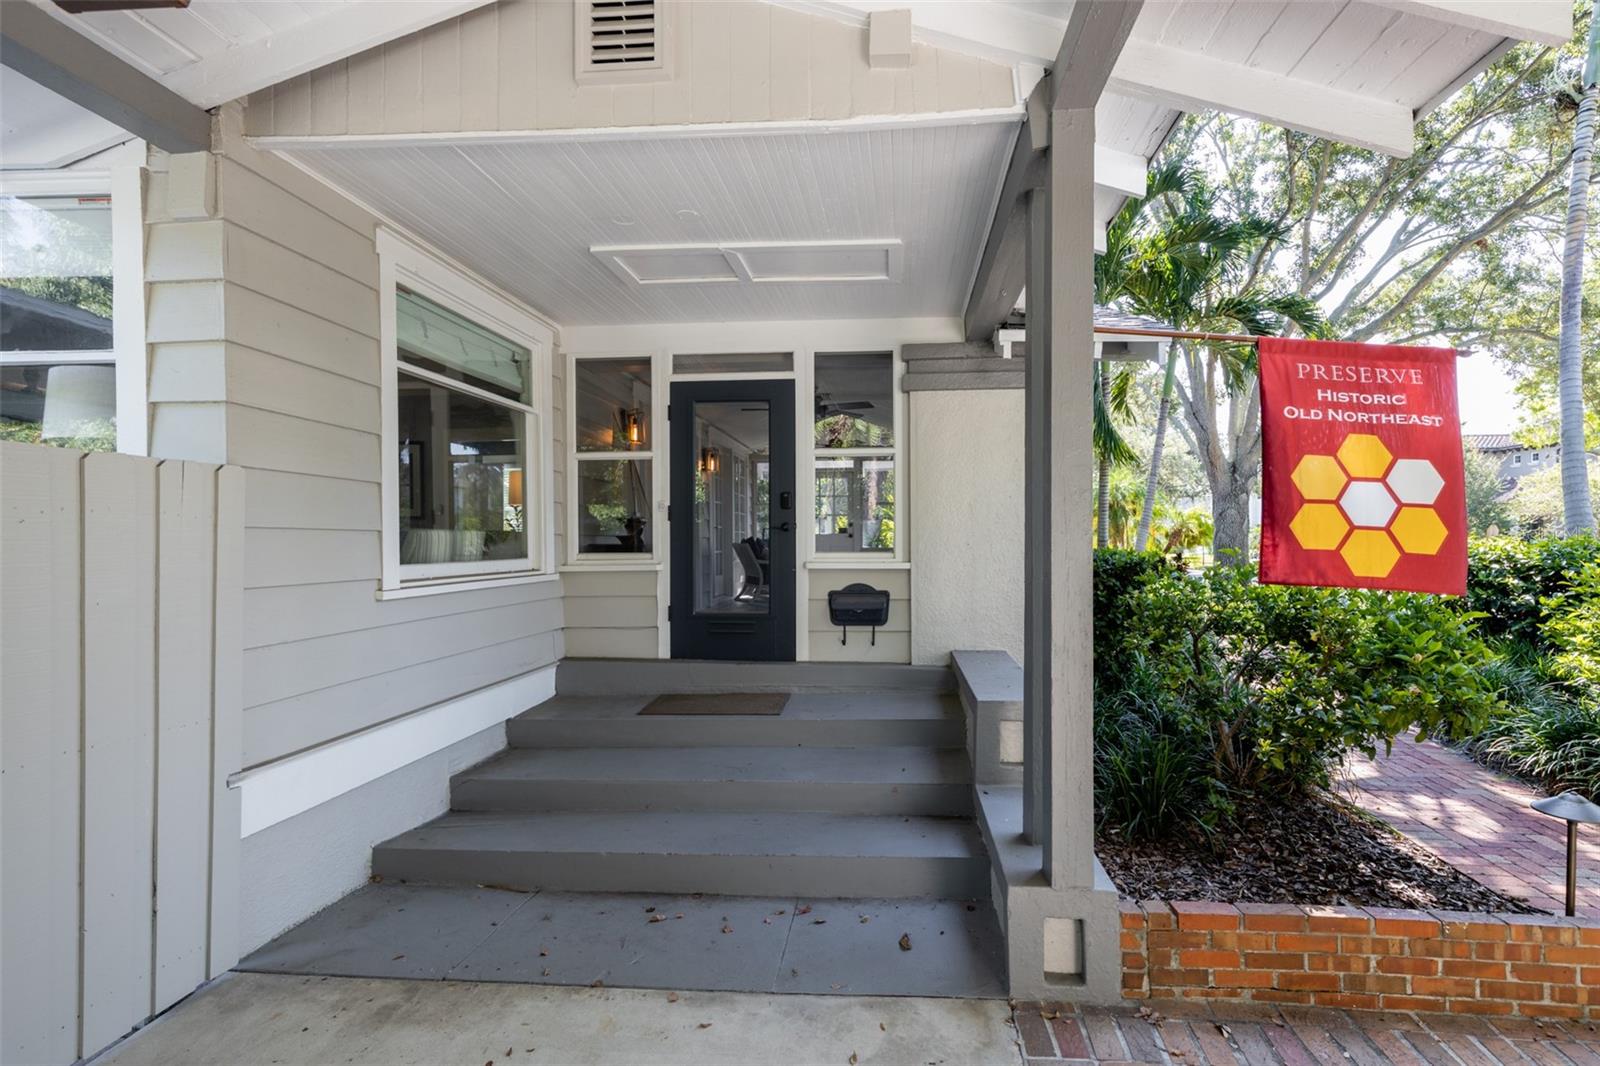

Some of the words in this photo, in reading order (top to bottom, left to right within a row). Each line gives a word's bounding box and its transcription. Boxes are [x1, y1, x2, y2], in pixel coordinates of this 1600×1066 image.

[1296, 363, 1423, 385] PRESERVE
[1317, 389, 1407, 405] HISTORIC
[1284, 406, 1322, 420] OLD
[1327, 409, 1443, 427] NORTHEAST
